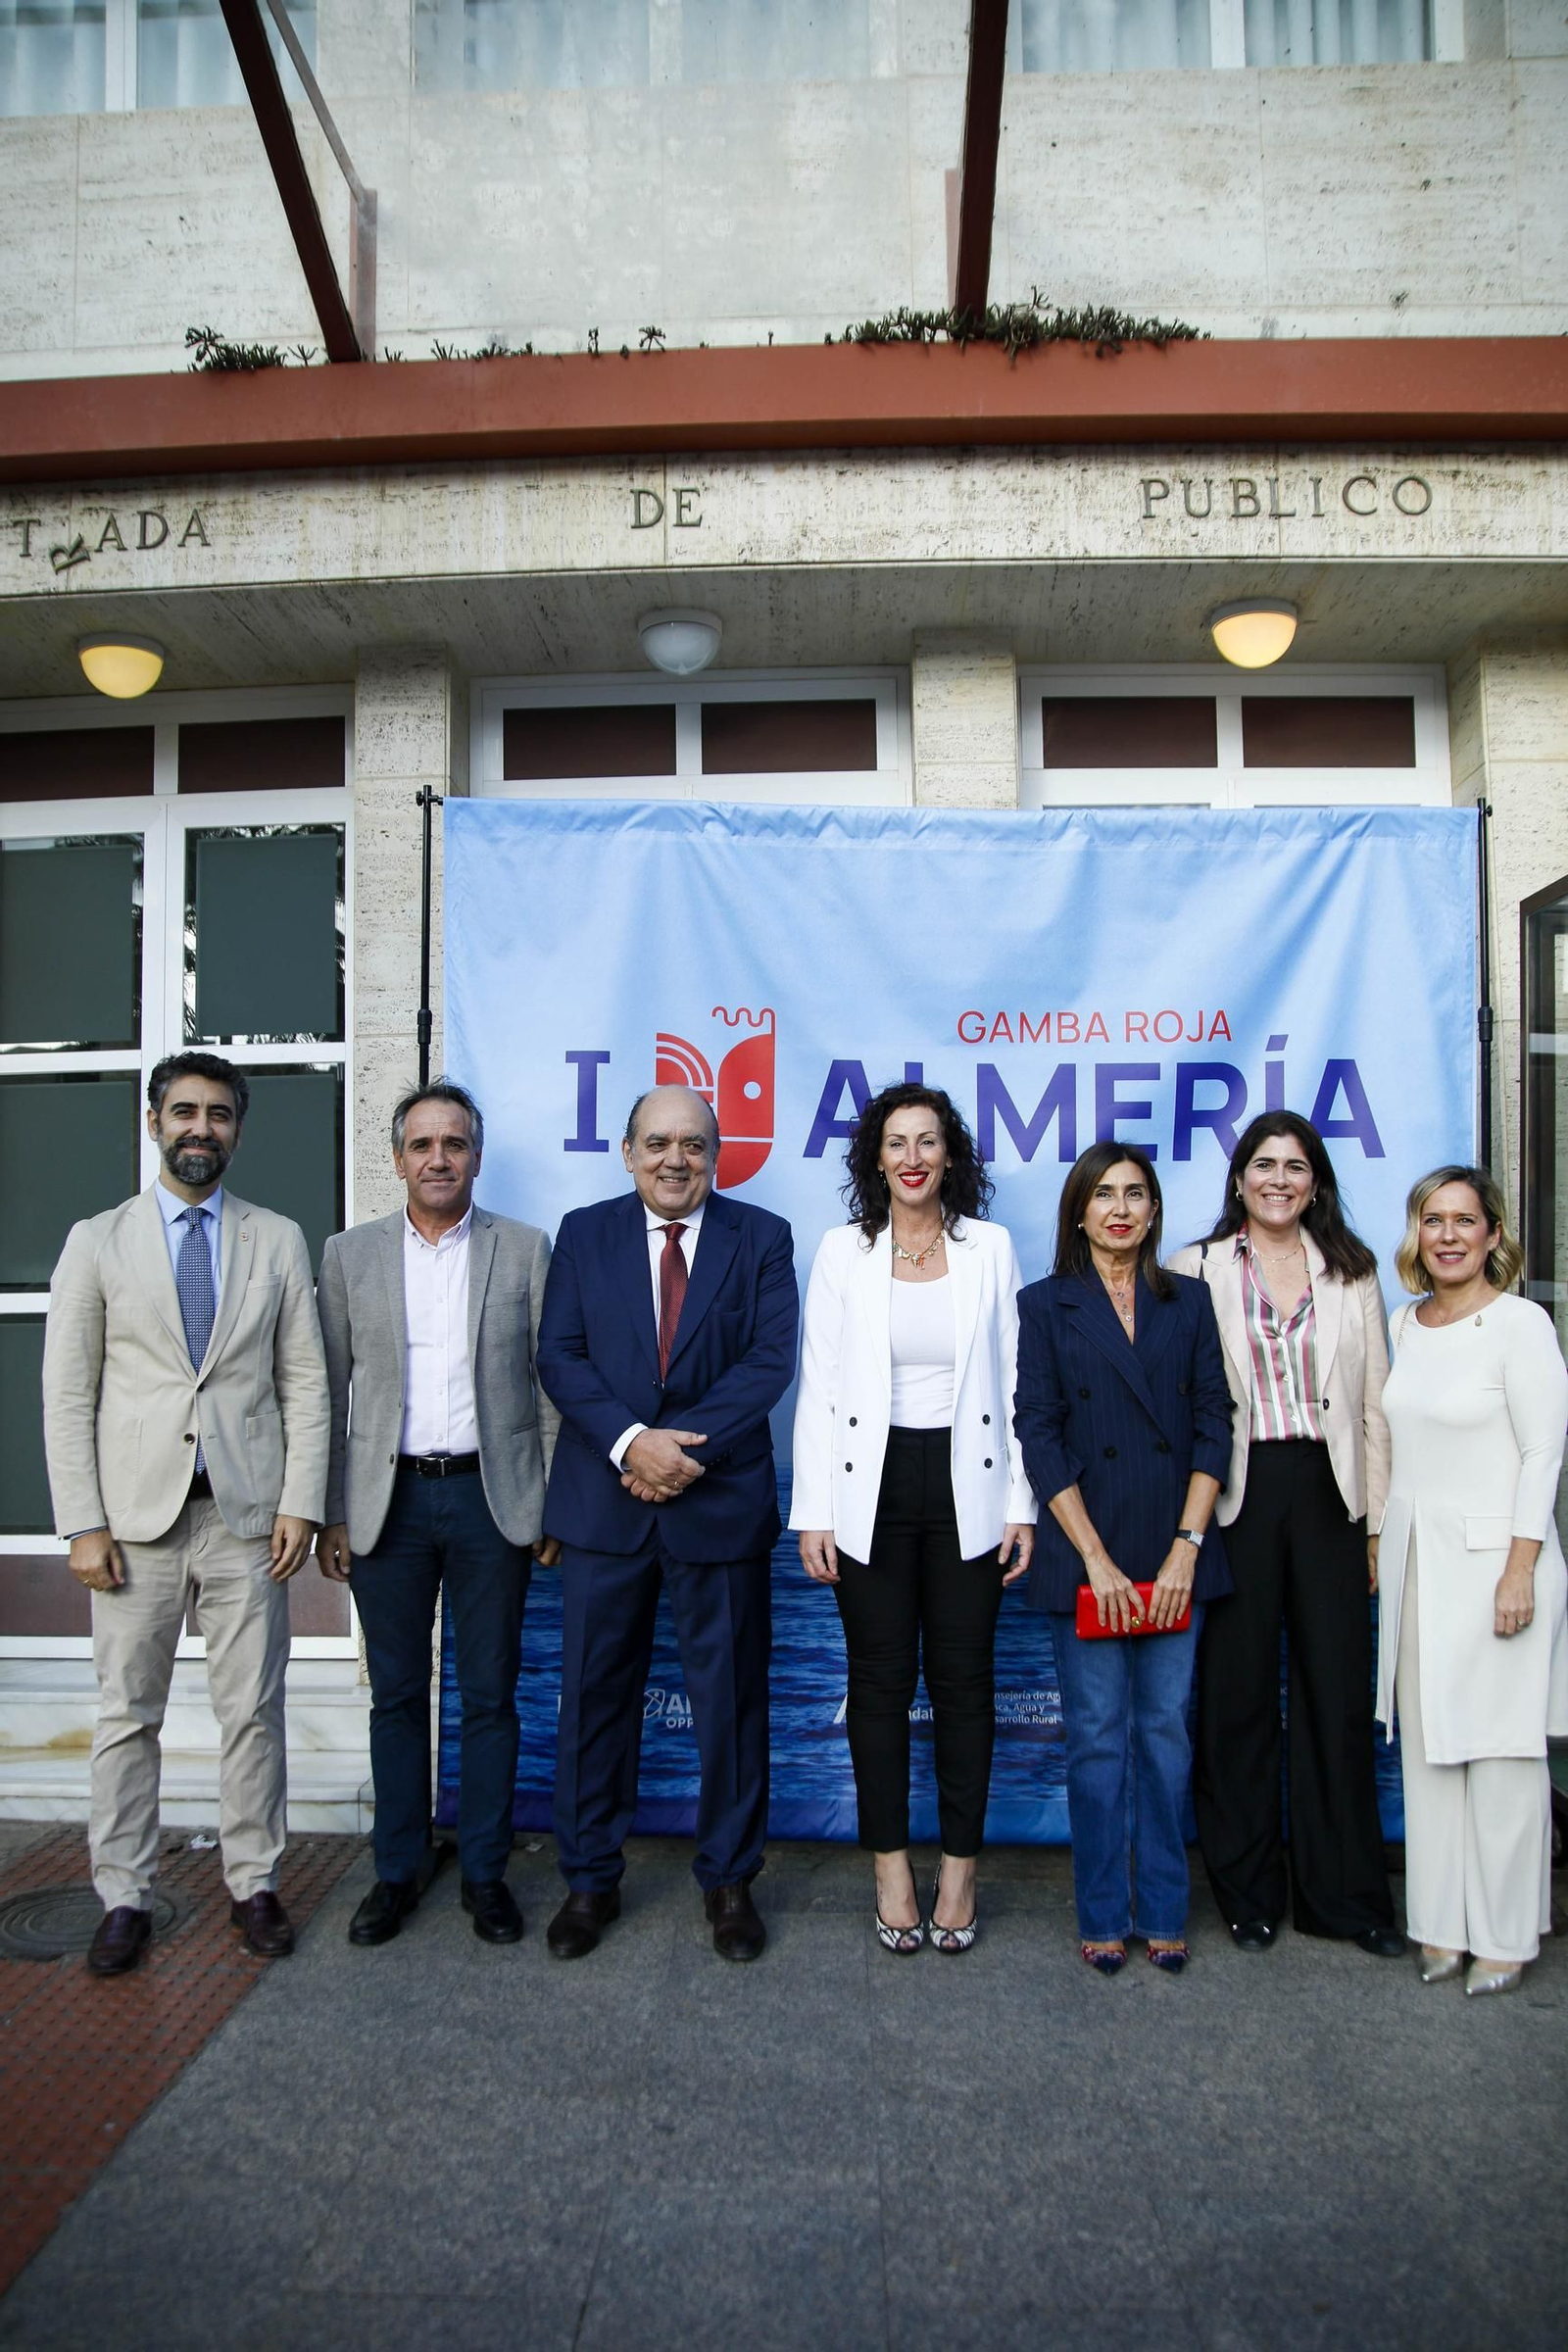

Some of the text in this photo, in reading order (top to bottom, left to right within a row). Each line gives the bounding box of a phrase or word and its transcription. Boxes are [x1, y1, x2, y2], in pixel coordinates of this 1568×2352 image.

[629, 487, 703, 528] DE
[1140, 474, 1433, 518] PUBLICO
[957, 1009, 1232, 1044] GAMBA ROJA
[564, 1034, 1386, 1162] I AMERÍA
[1032, 1690, 1045, 1700] de
[1032, 1714, 1057, 1724] Rural
